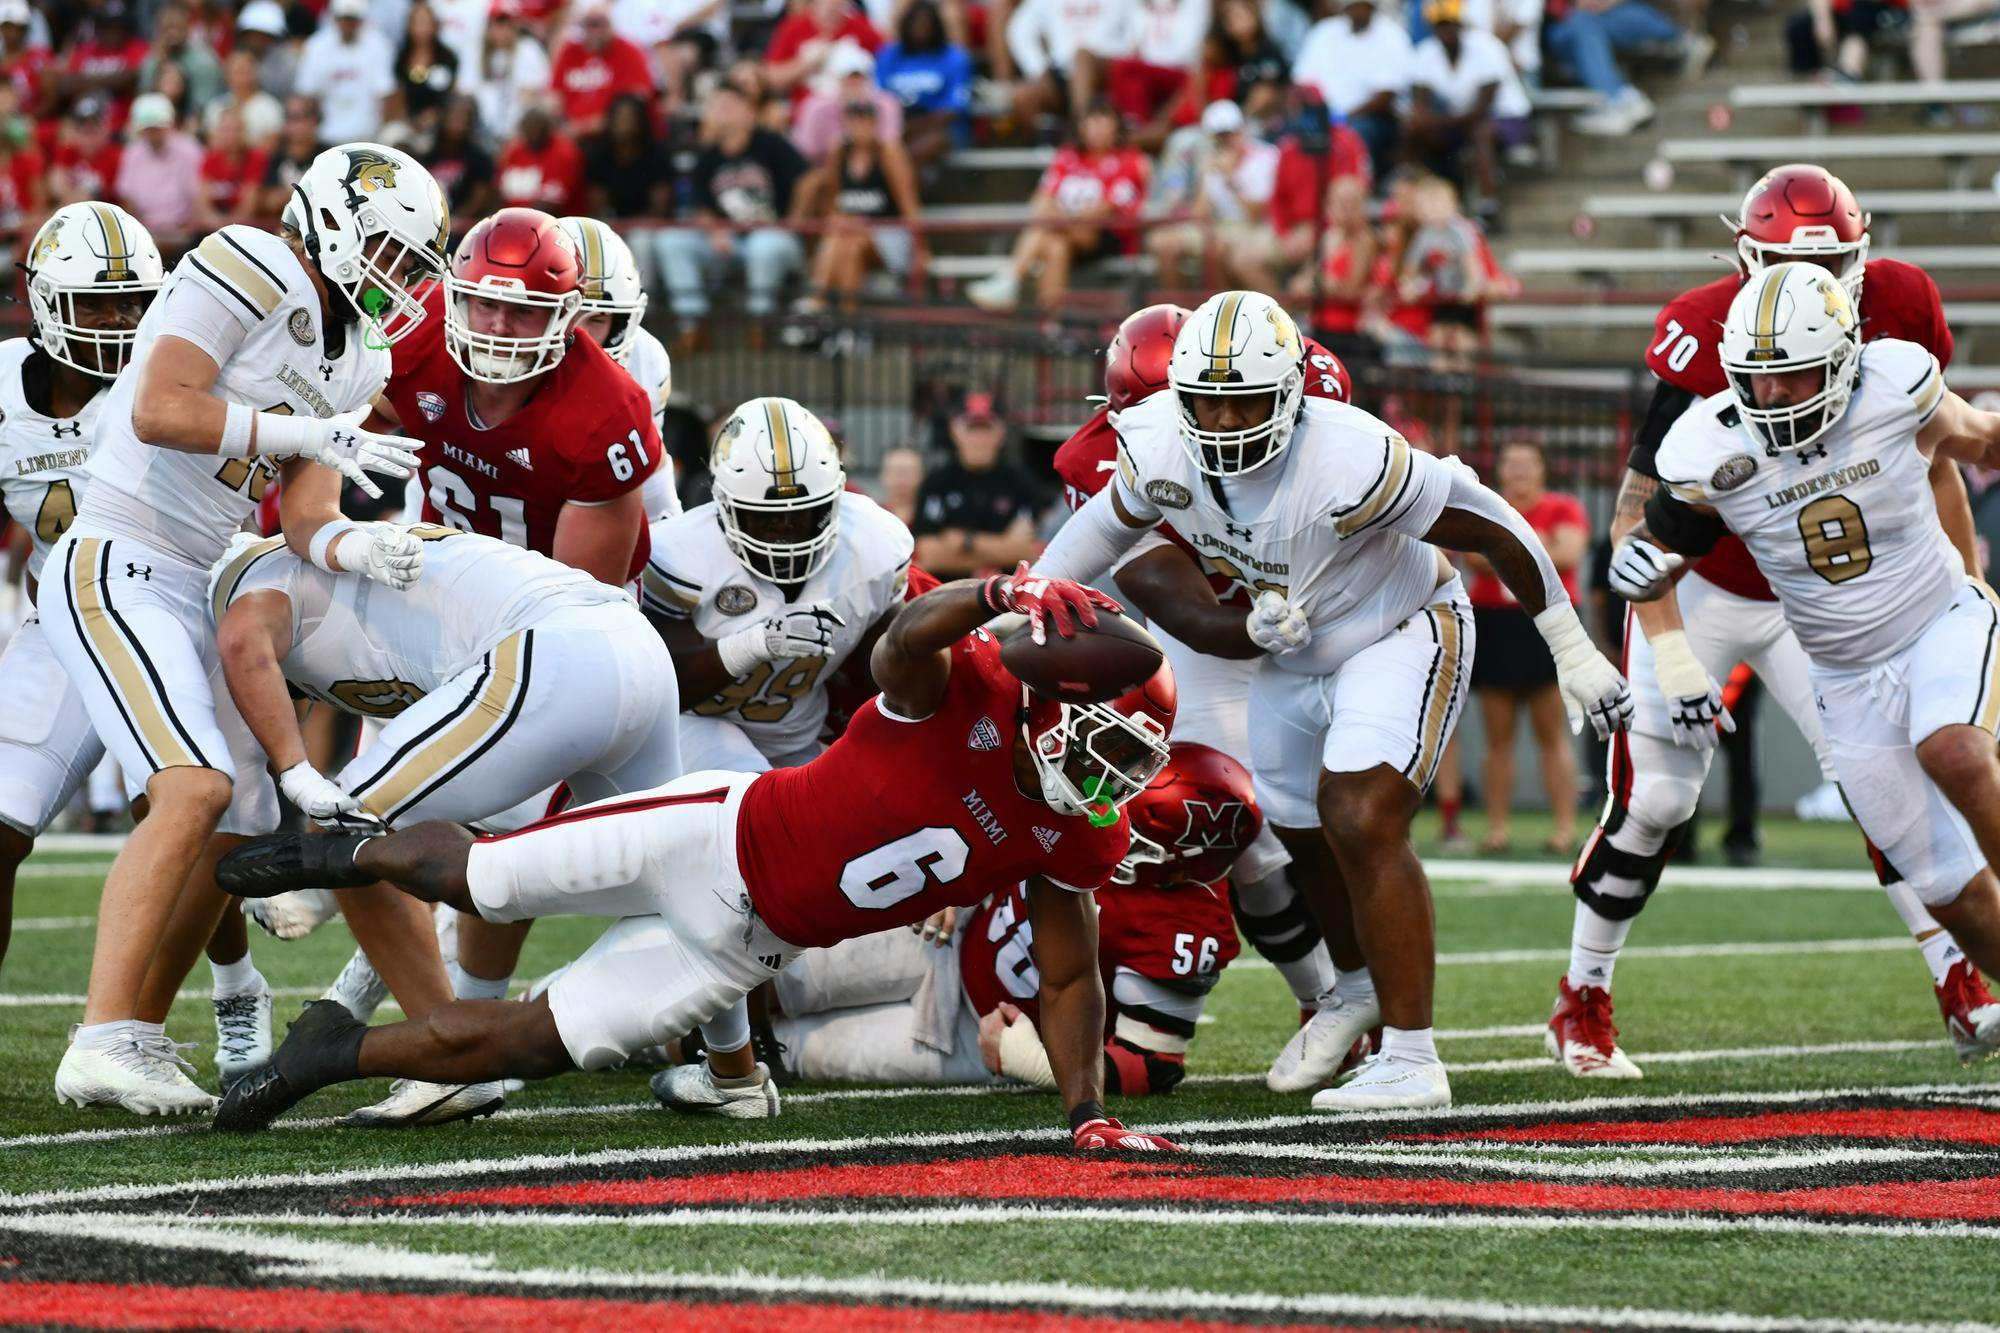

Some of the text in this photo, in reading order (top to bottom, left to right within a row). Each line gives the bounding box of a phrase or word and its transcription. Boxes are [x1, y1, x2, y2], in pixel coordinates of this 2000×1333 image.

[1652, 317, 1700, 374] 70
[442, 440, 499, 481] MIAMI
[606, 428, 651, 483] 61
[1764, 457, 1882, 510] LINDENWOOD
[34, 478, 78, 545] 4
[427, 463, 530, 552] 61
[1796, 493, 1875, 586] 8
[961, 788, 1009, 847] MIAMI
[1031, 825, 1055, 854] adidas
[1173, 798, 1245, 849] M
[837, 824, 974, 911] 6
[1170, 931, 1220, 977] 56
